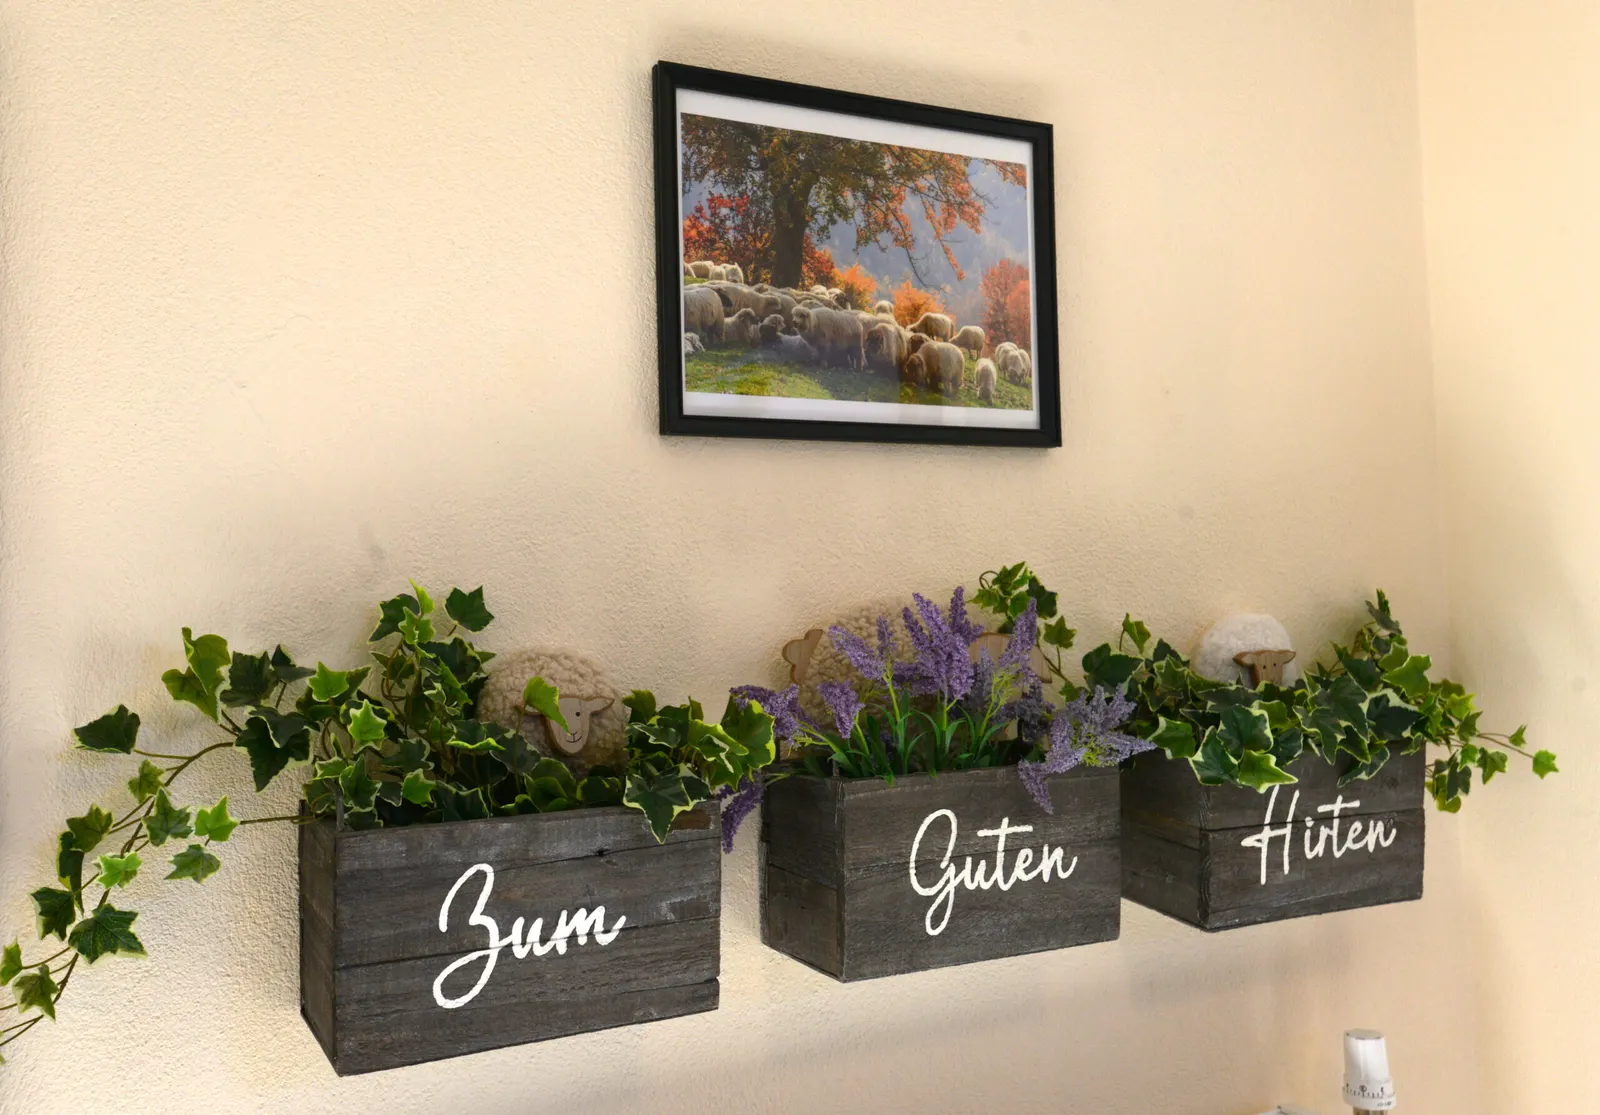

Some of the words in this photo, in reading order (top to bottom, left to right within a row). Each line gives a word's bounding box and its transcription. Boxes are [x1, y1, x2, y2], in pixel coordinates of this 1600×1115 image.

[909, 809, 1077, 936] Guten
[1241, 784, 1397, 885] Hirten
[433, 864, 626, 1009] Zum
